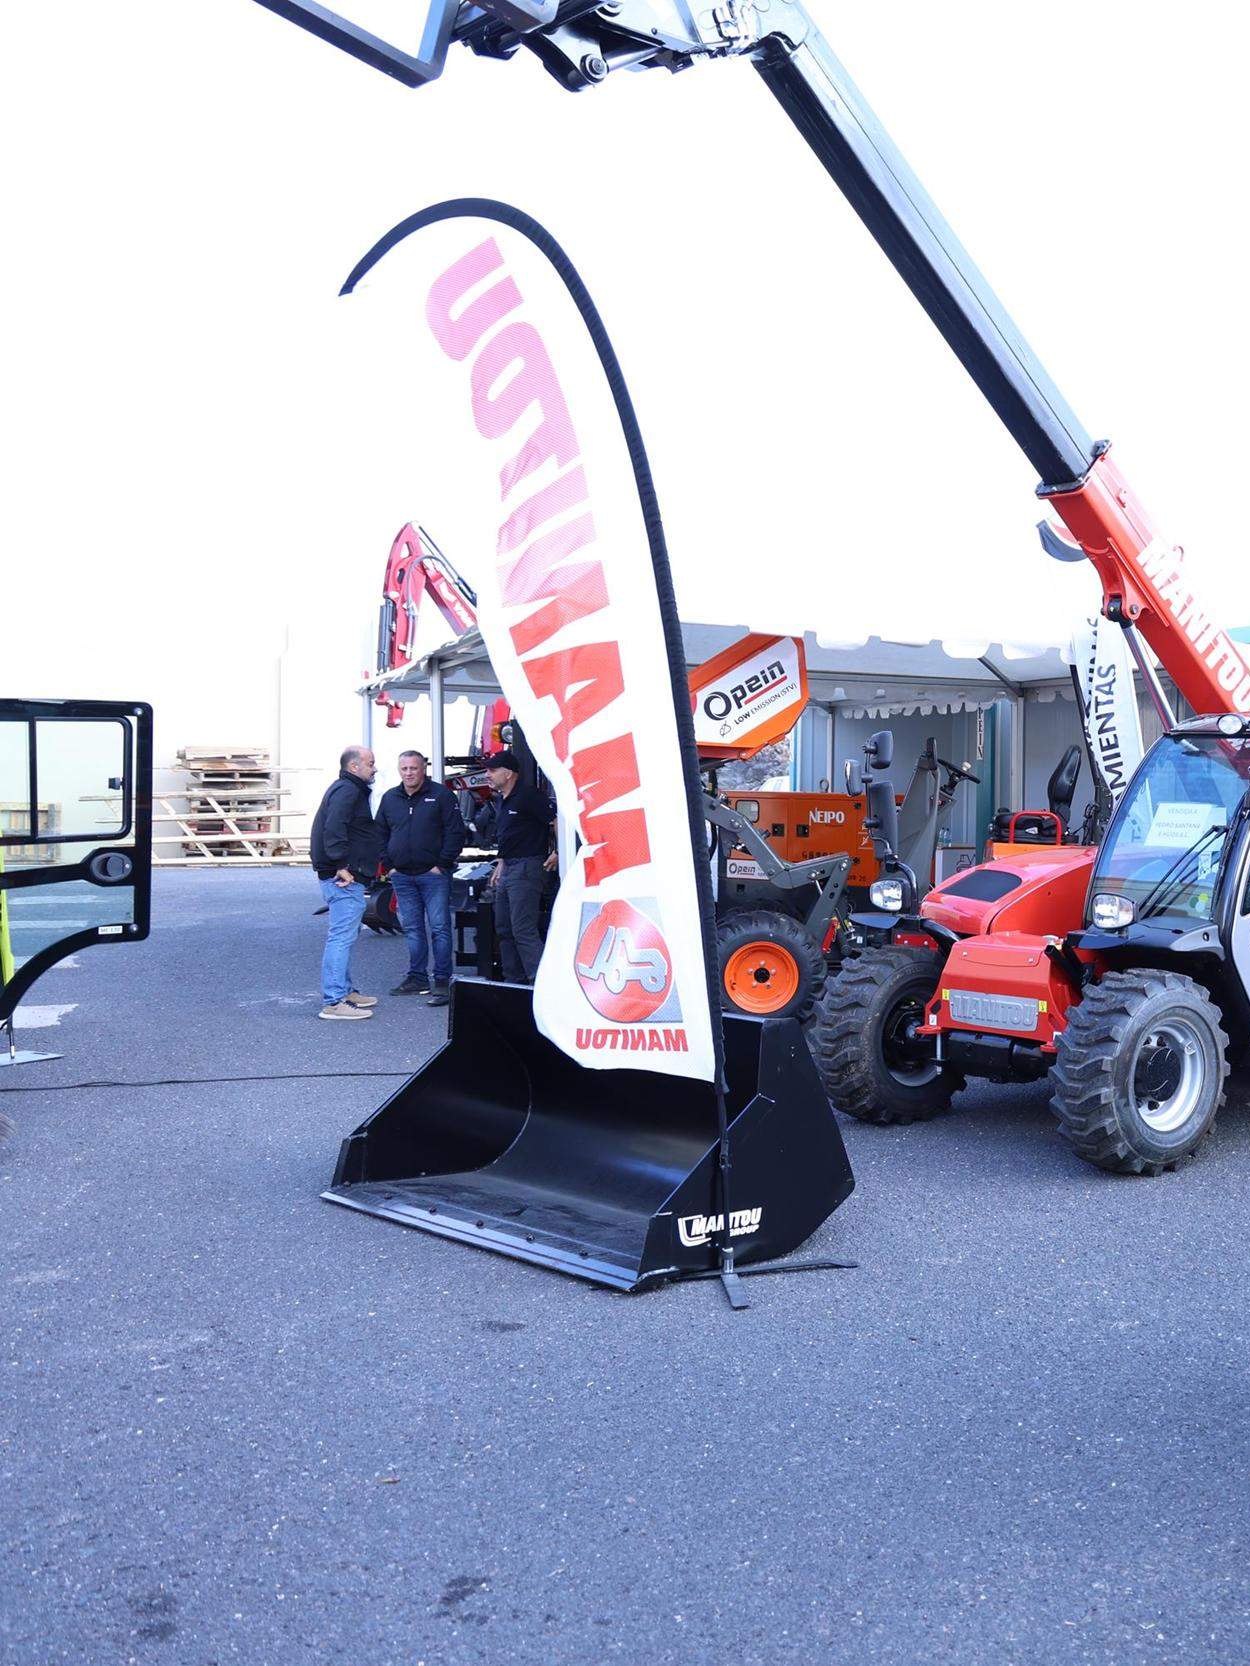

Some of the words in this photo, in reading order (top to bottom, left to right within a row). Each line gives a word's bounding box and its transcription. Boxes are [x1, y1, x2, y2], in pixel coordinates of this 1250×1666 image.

[703, 660, 786, 721] Opein
[733, 711, 751, 725] LOW
[751, 693, 781, 714] EMISSION
[1095, 663, 1127, 800] MIENTAS
[729, 863, 756, 875] Opein
